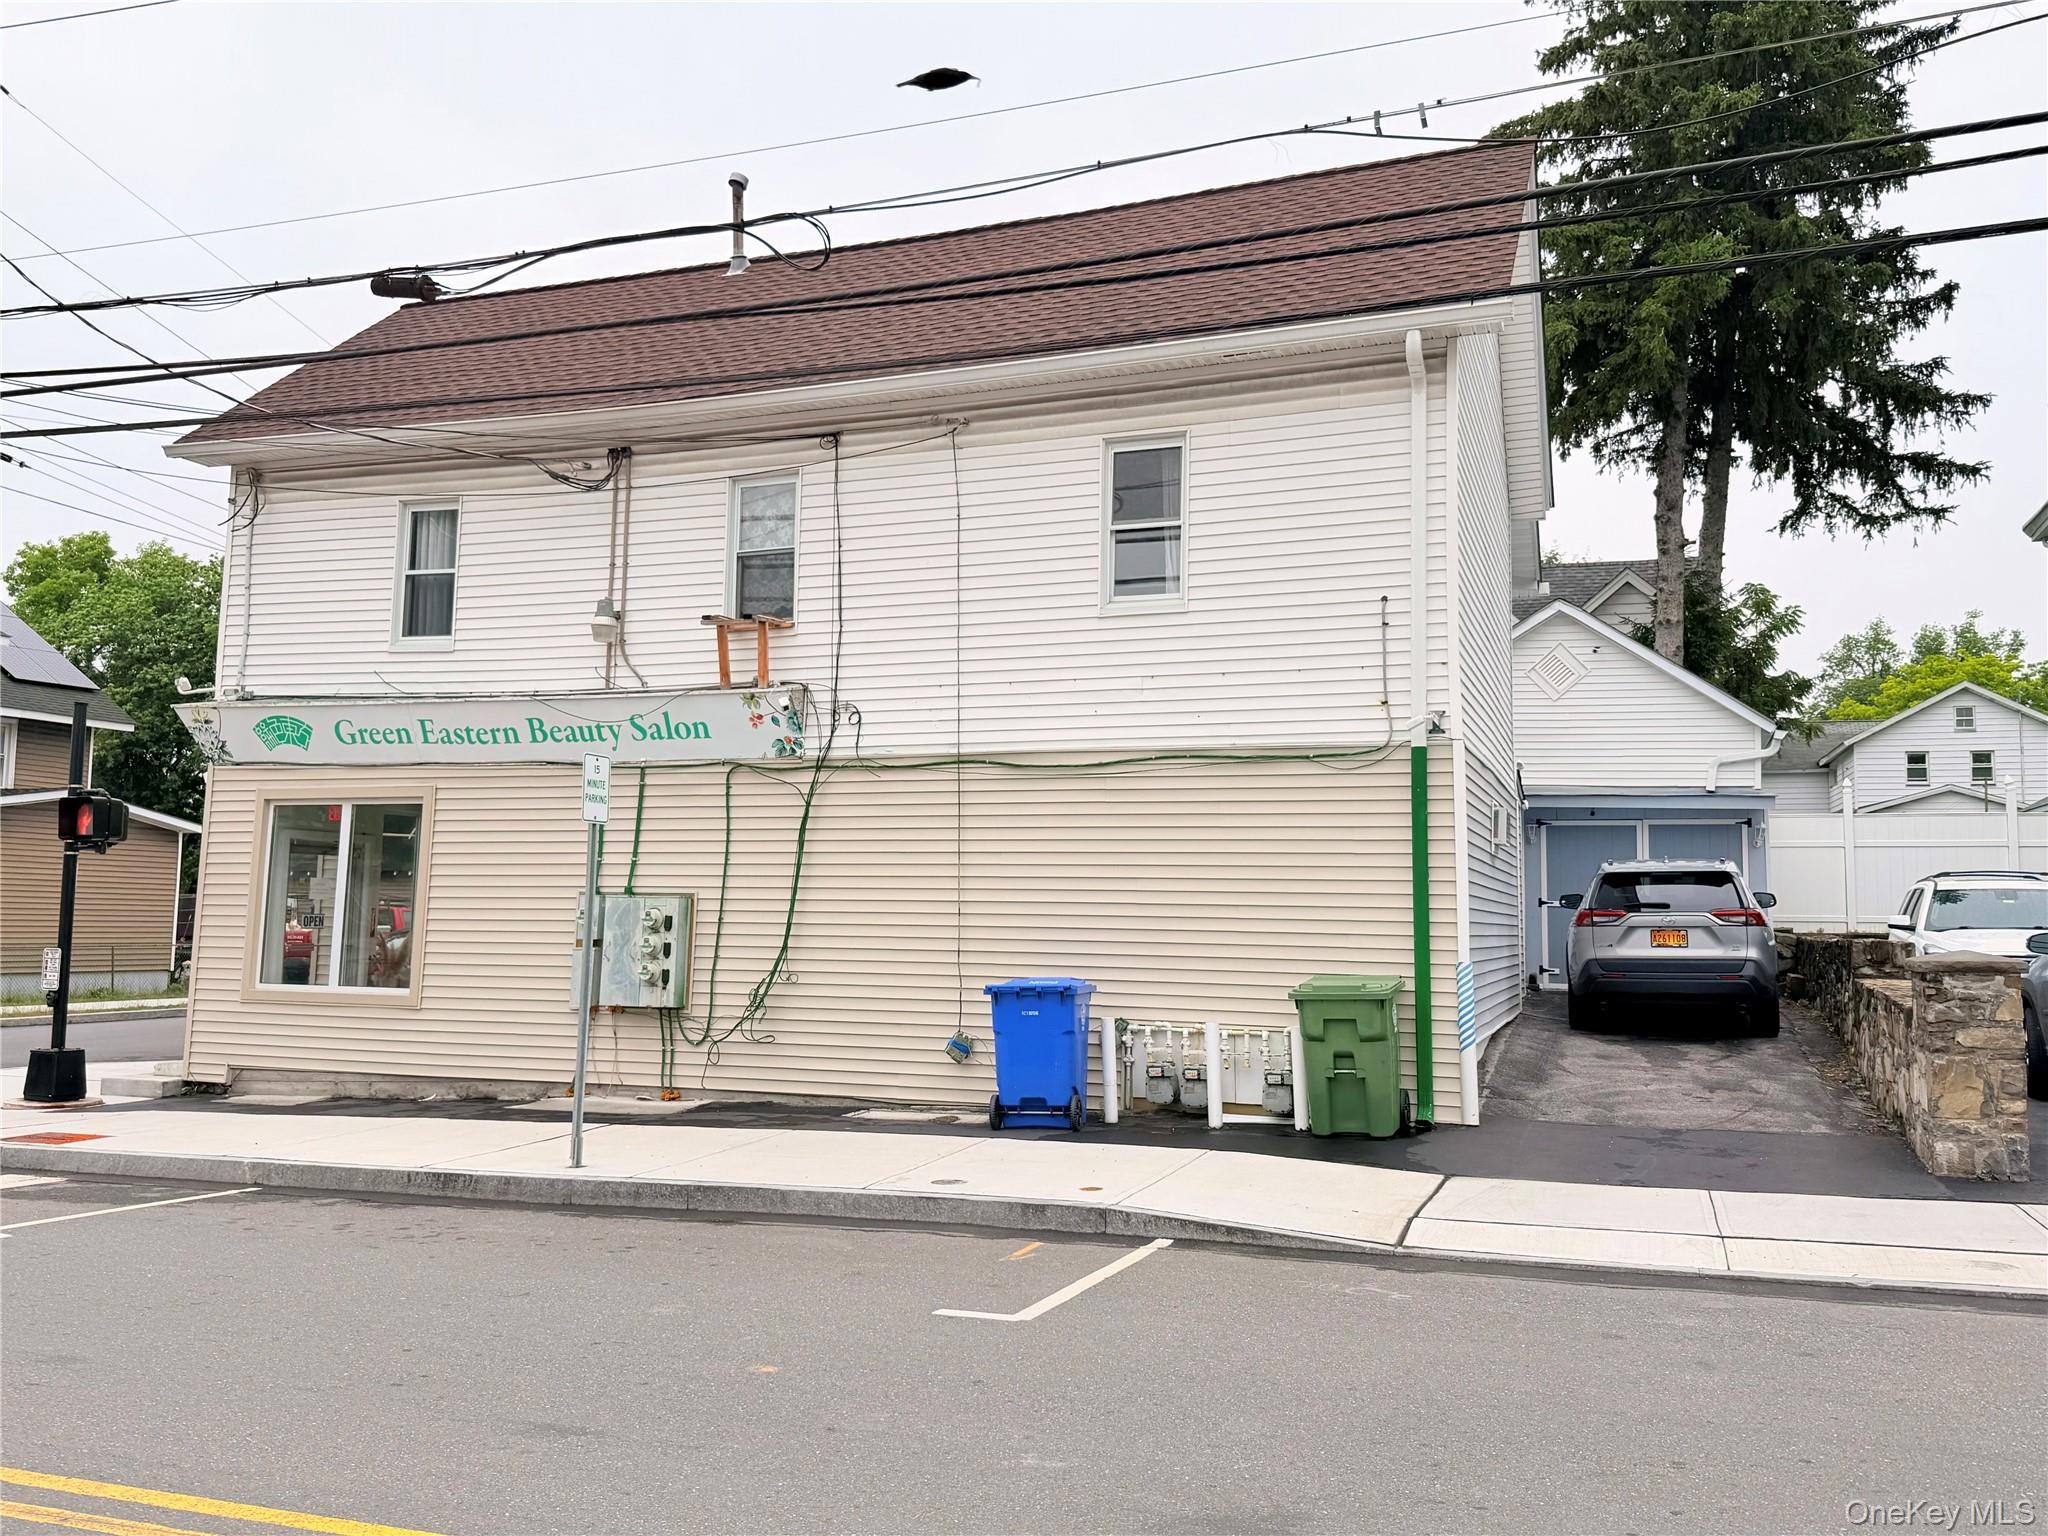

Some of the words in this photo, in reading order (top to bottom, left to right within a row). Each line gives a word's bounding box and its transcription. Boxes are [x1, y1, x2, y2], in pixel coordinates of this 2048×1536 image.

[334, 719, 413, 745] Green
[417, 718, 522, 746] Eastern
[525, 716, 622, 751] Beauty
[629, 710, 712, 742] Salon
[593, 764, 601, 775] 15
[587, 778, 606, 790] MINUTE
[585, 792, 607, 805] PARKING
[303, 915, 325, 927] OPEN
